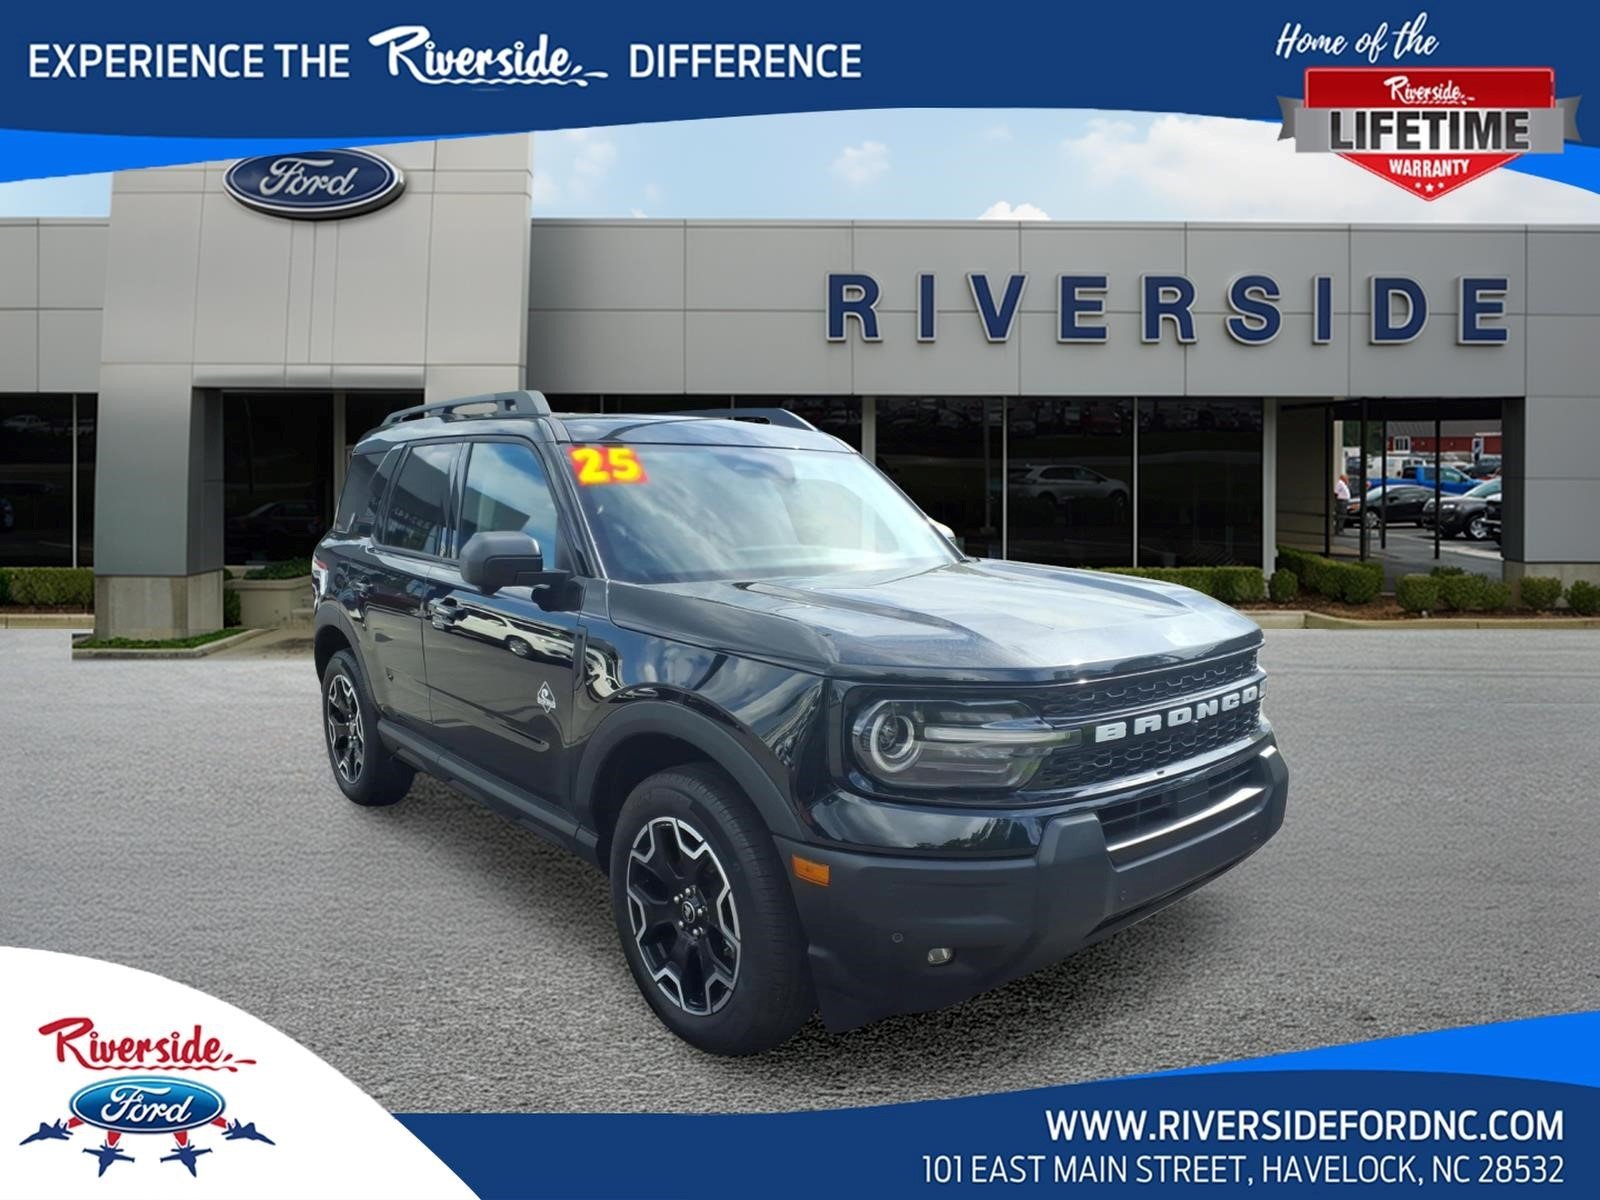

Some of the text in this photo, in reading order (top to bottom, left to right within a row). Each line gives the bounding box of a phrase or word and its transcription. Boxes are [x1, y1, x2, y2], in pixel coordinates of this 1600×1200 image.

[259, 157, 359, 196] Ford
[825, 272, 1509, 346] RIVERSIDE
[570, 447, 643, 484] 25
[1095, 685, 1258, 743] BRONCO
